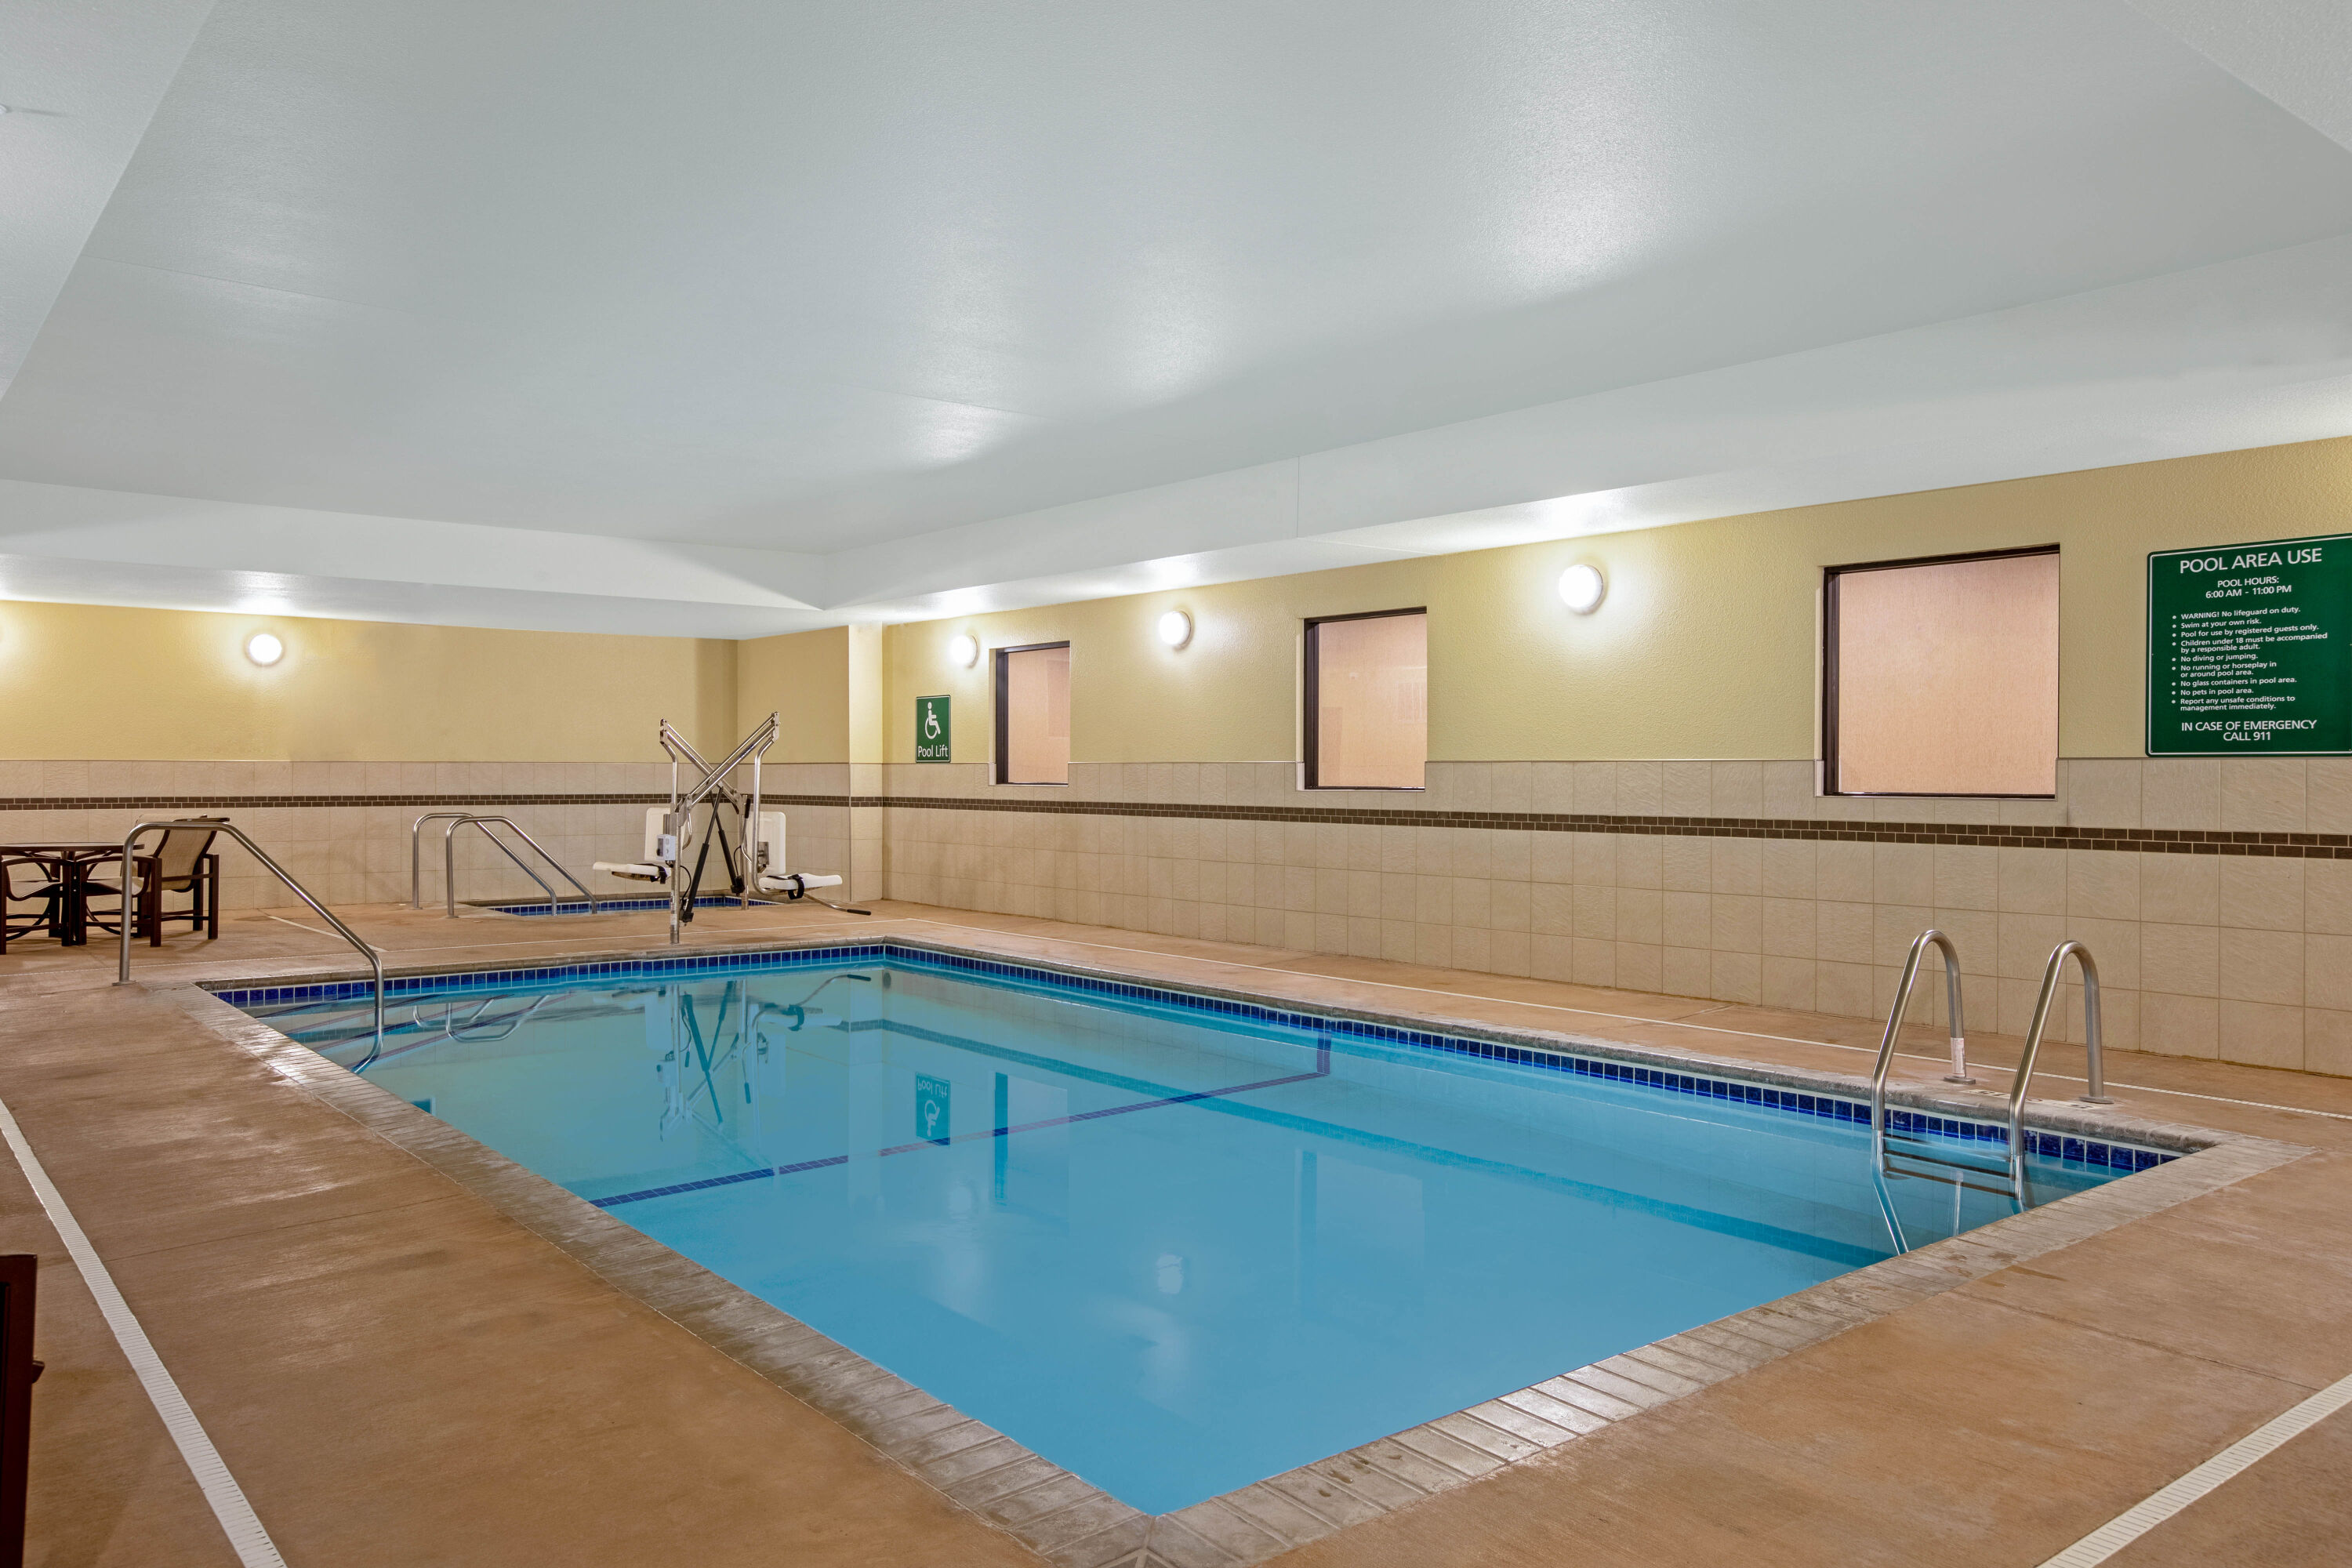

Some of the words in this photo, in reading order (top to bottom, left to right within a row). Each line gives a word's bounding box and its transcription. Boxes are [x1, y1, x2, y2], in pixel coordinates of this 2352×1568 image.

[2180, 557, 2227, 573] POOL
[2231, 552, 2282, 570] AREA
[2287, 548, 2322, 564] USE
[2217, 579, 2242, 588] POOL
[2245, 576, 2280, 586] HOURS:
[2225, 589, 2242, 597] AM
[2252, 586, 2274, 595] 11:00
[2277, 585, 2292, 593] PM
[2181, 612, 2220, 620] WARNING!
[2234, 608, 2267, 617] lifeguard
[2235, 626, 2272, 636] registered
[2277, 633, 2328, 642] accompanied
[2198, 644, 2237, 654] responsible
[2225, 653, 2258, 662] jumping.
[2193, 664, 2220, 673] running
[2232, 662, 2267, 671] horseplay
[2217, 670, 2234, 678] pool
[2259, 677, 2276, 686] pool
[2217, 688, 2234, 697] pool
[2181, 722, 2193, 731] IN
[2195, 721, 2223, 731] CASE
[2225, 721, 2241, 731] OF
[2243, 720, 2318, 731] EMERGENCY
[2223, 732, 2251, 741] CALL
[2253, 731, 2271, 741] 911
[918, 745, 933, 757] Pool
[935, 745, 948, 757] Lift
